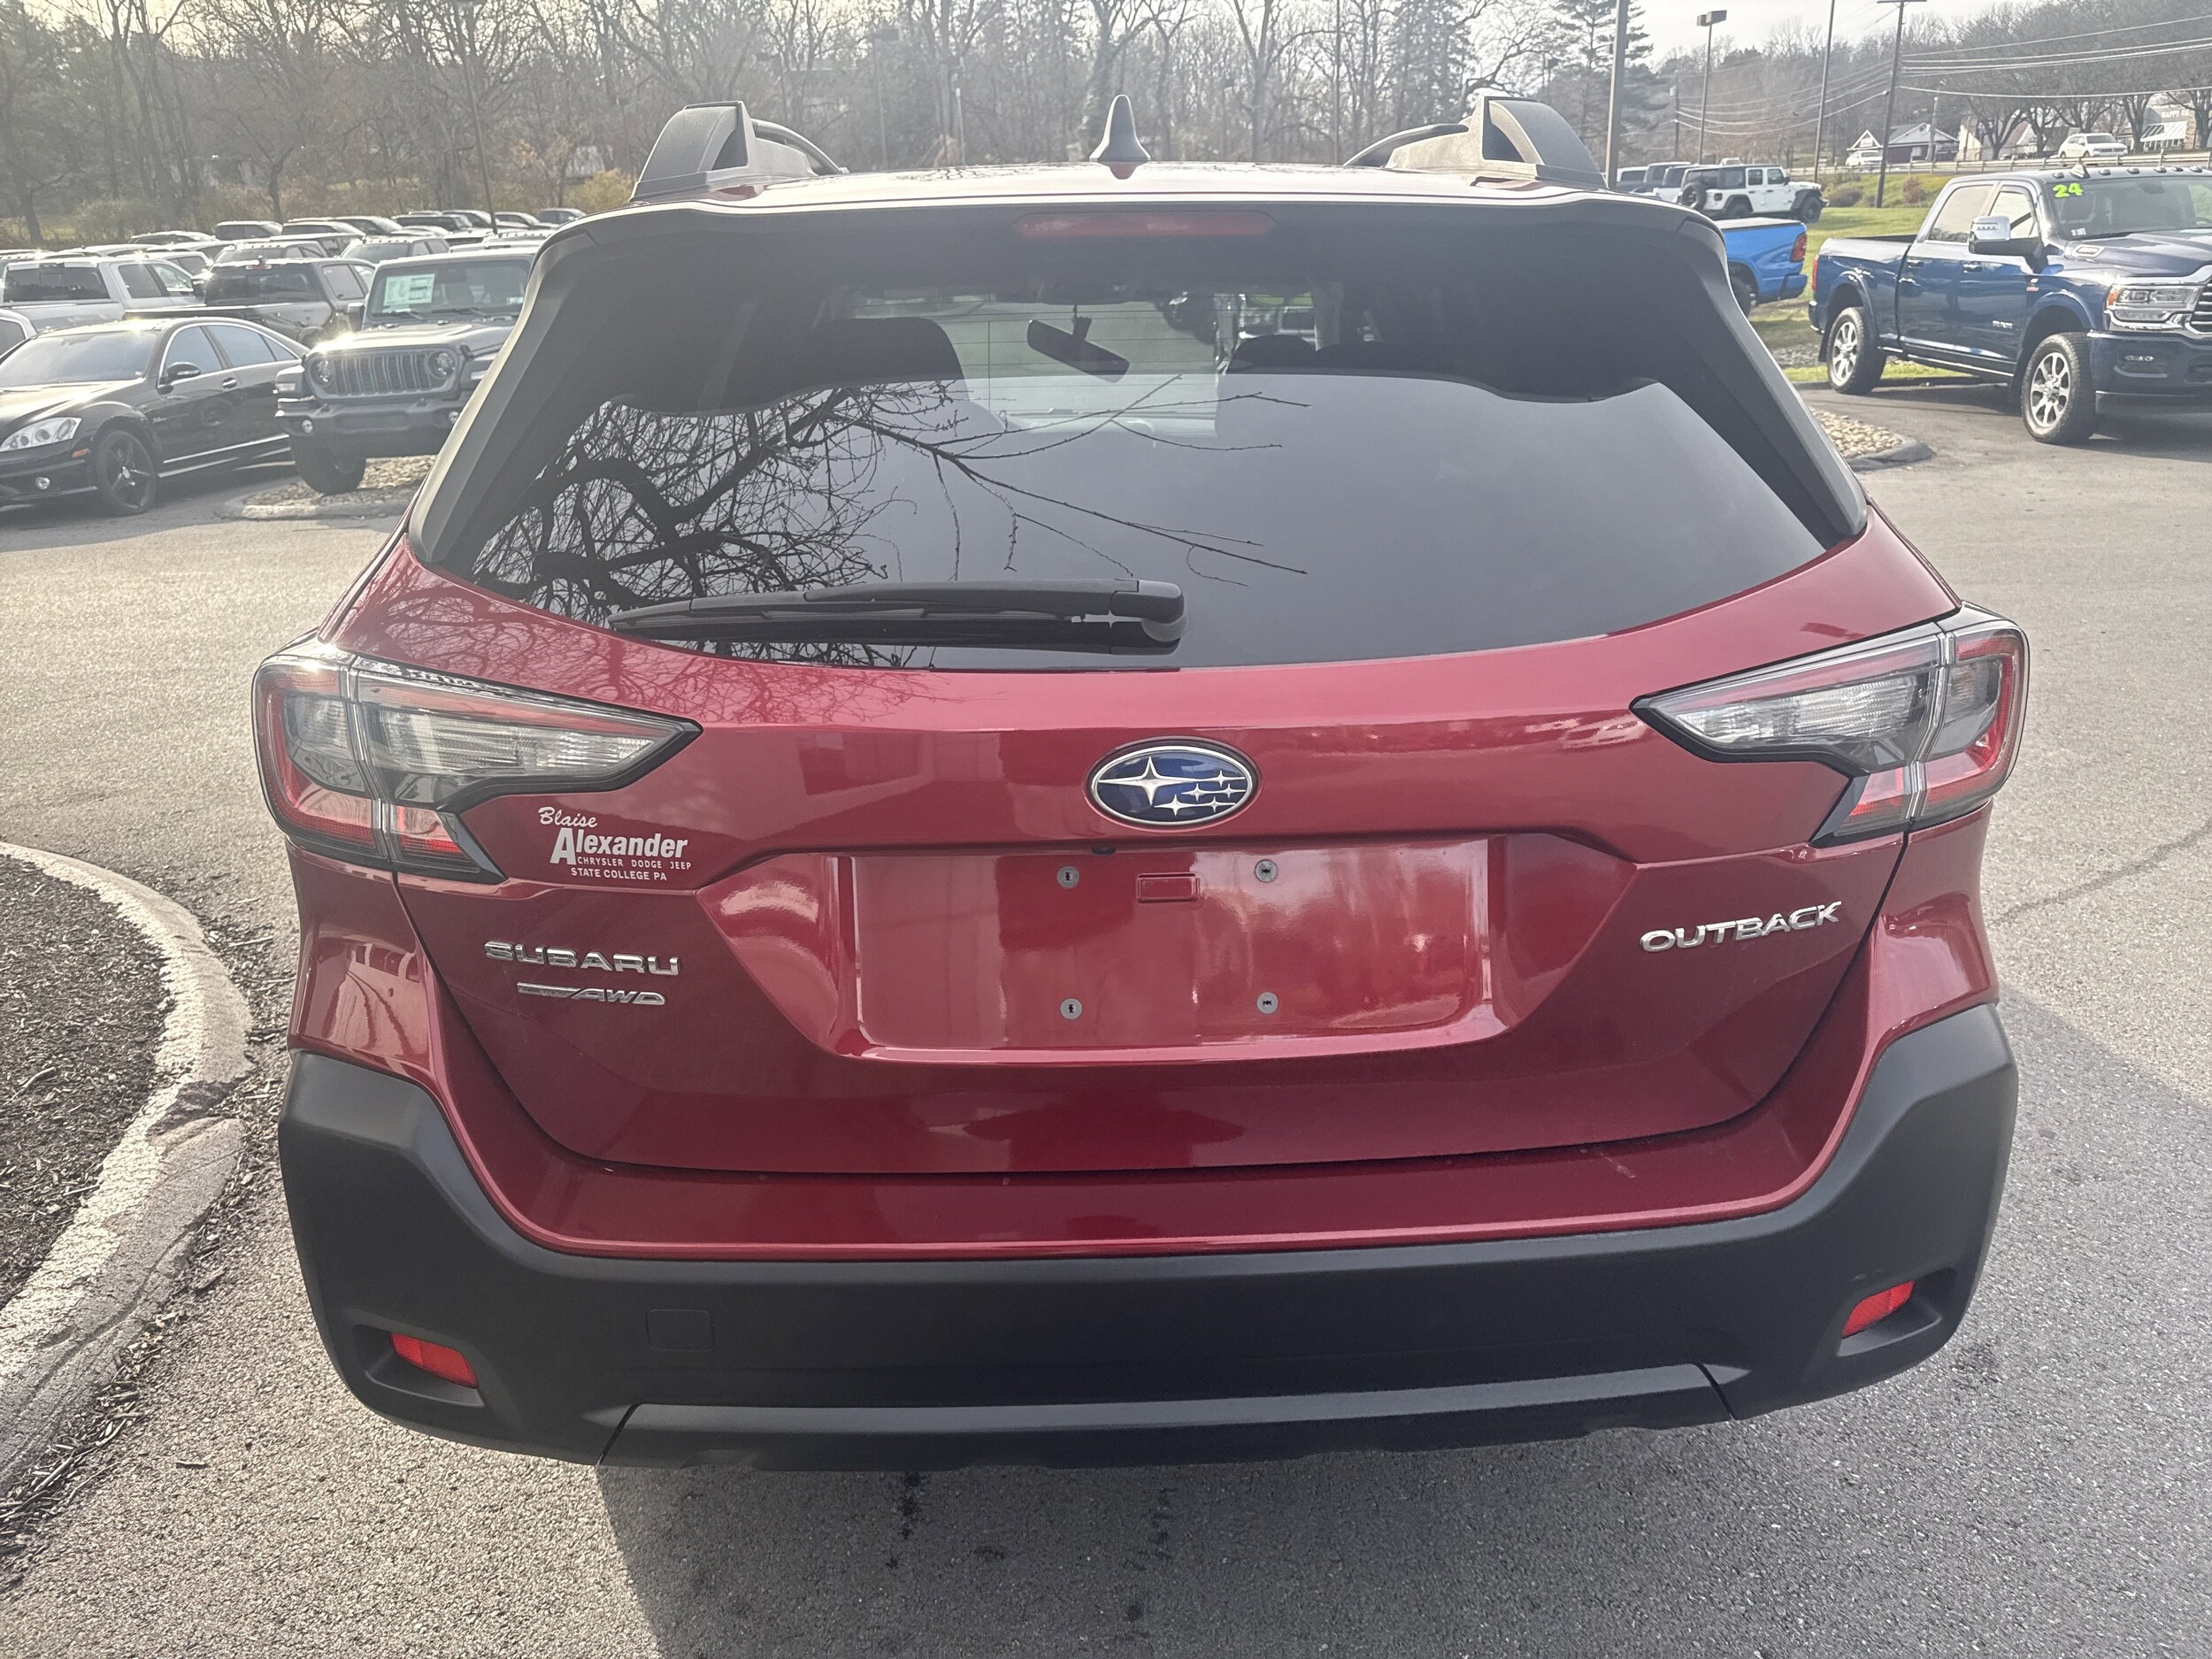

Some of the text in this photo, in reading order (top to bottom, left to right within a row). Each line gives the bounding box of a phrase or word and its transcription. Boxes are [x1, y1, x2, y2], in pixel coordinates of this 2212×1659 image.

[2053, 182, 2084, 198] 24
[538, 806, 597, 828] Blaise
[549, 827, 688, 865] Alexander
[577, 856, 692, 871] CHRYSLER DODGE JEEP
[571, 867, 667, 881] STATE COLLEGE PA
[1639, 901, 1842, 952] OUTBACK
[484, 941, 680, 976] SUBARU
[571, 988, 665, 1006] AWD
